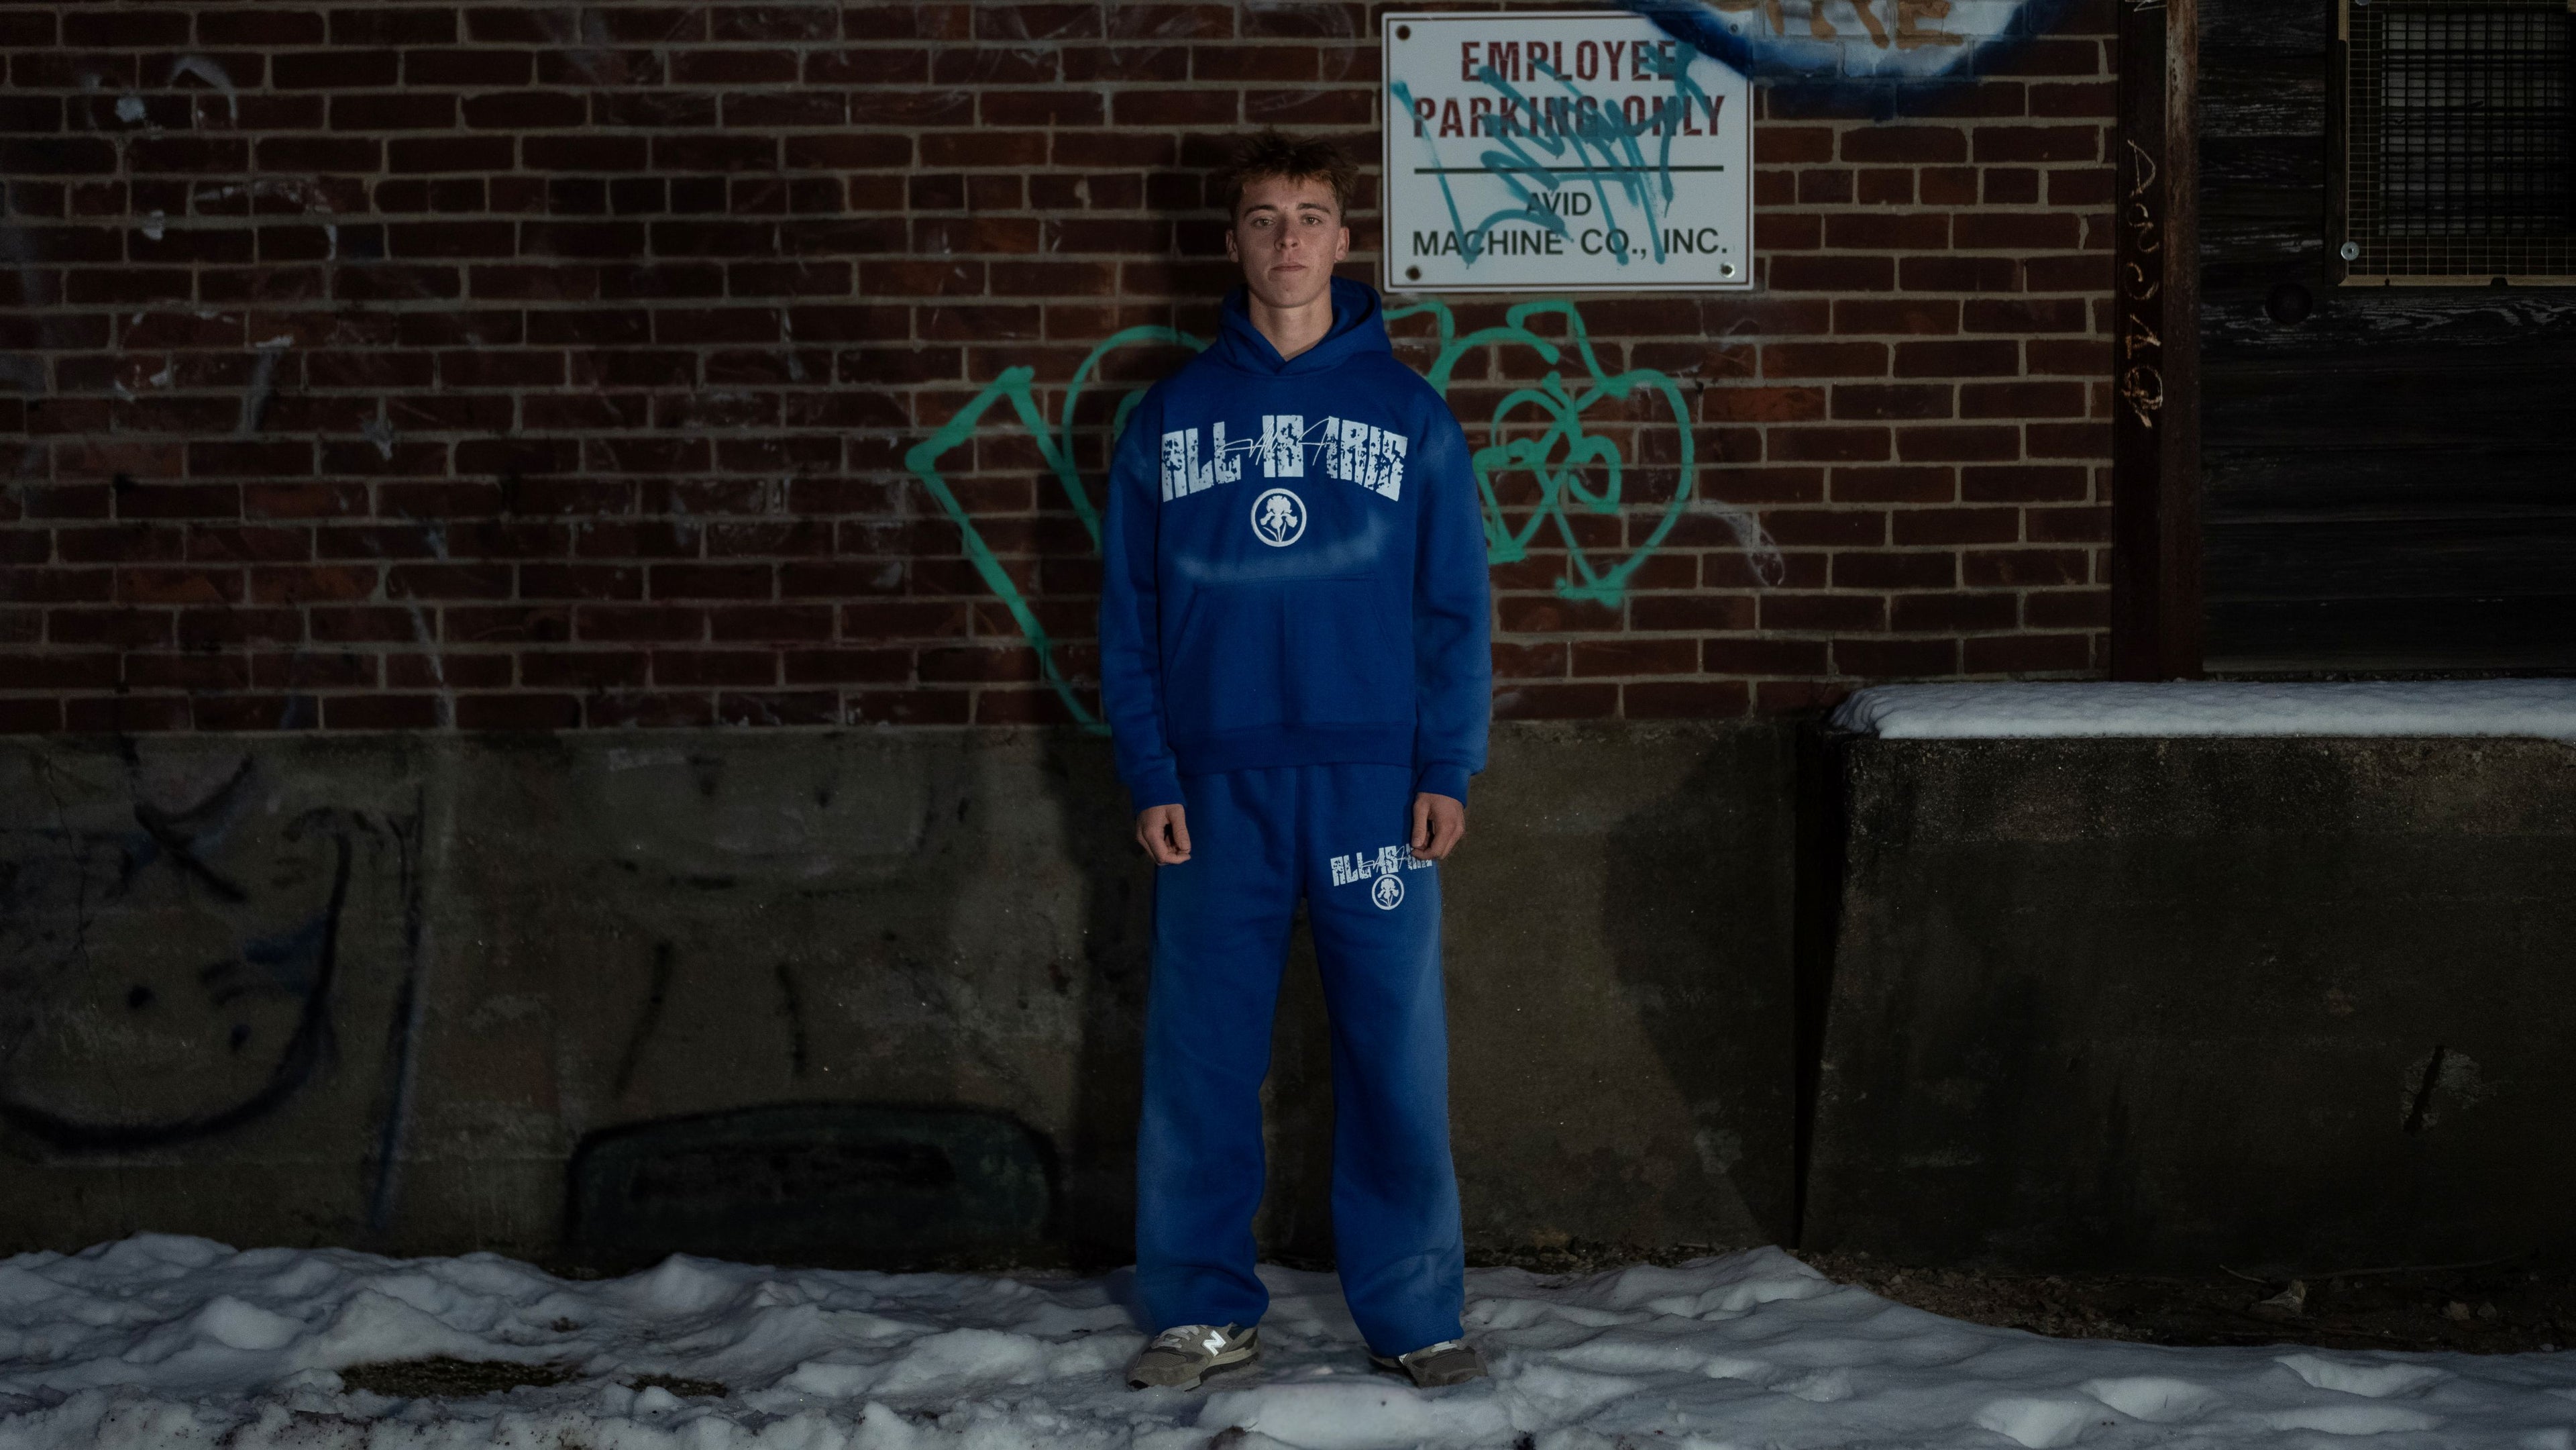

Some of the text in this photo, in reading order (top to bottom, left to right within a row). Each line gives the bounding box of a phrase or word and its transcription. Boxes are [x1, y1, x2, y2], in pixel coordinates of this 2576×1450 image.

[1461, 40, 1677, 82] EMPLOYEE
[1413, 95, 1725, 138] PARKING ONLY
[1525, 192, 1592, 216] AVID
[1412, 228, 1729, 260] MACHINE CO., INC.
[1161, 421, 1242, 503] ALL
[1262, 414, 1304, 478] IS
[1330, 851, 1372, 887] ALL
